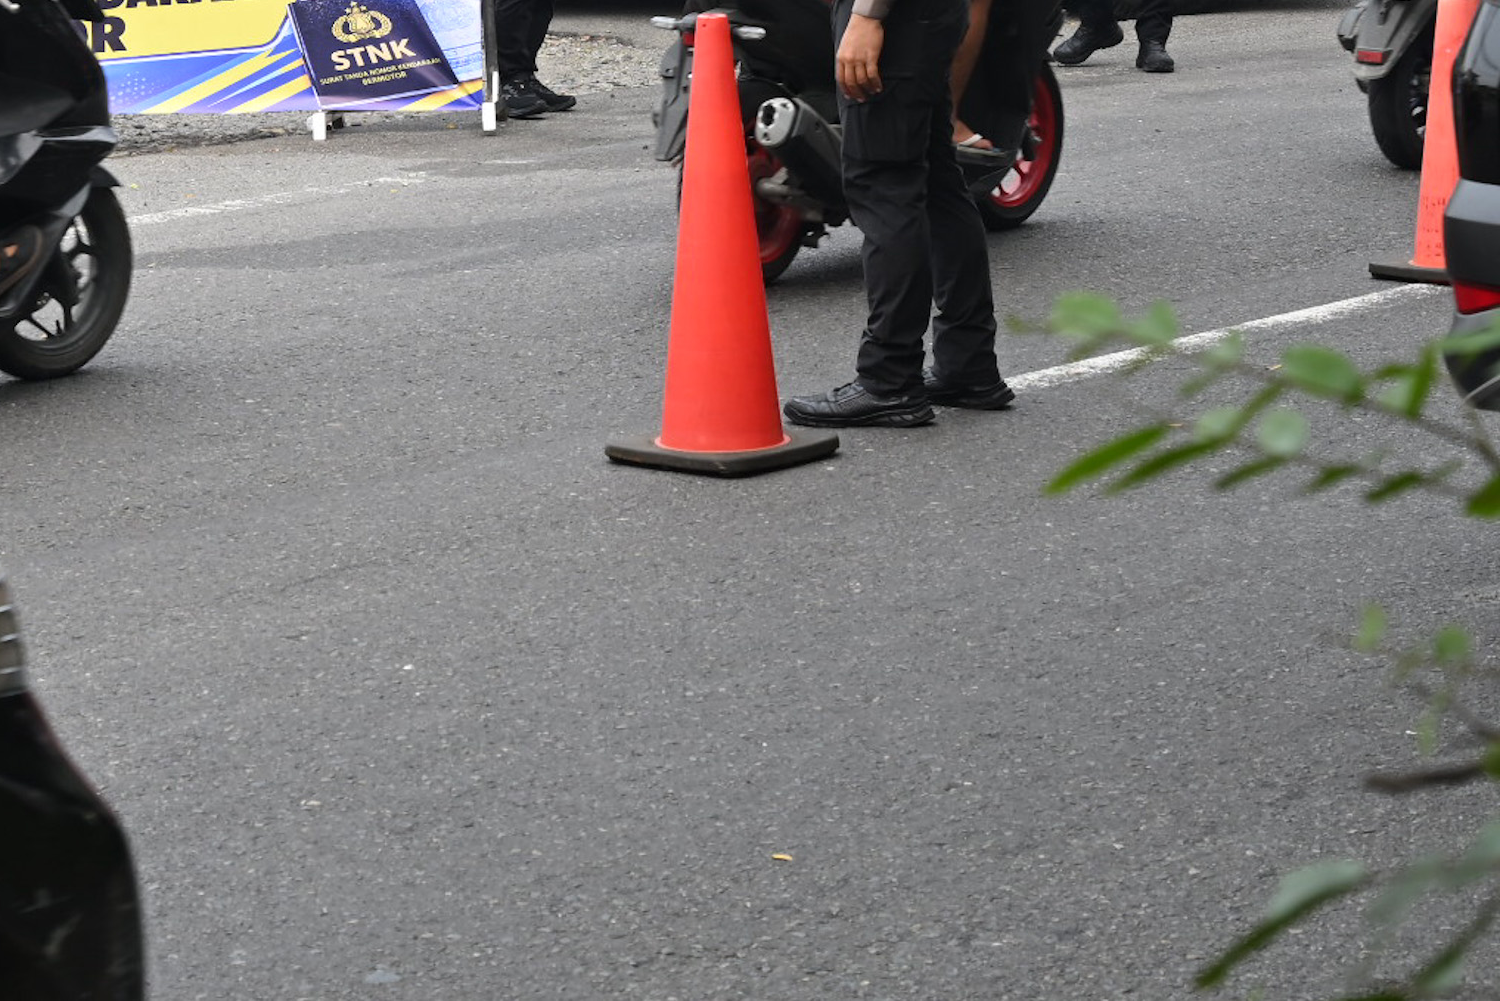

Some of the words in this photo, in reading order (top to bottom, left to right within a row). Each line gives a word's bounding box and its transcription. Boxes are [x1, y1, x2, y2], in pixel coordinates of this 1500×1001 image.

[331, 39, 416, 71] STNK
[319, 74, 344, 86] SURAT
[345, 70, 368, 81] TANDA
[369, 65, 397, 78] NOMOR
[398, 57, 441, 72] KENDARAAN
[362, 71, 407, 86] BERMOTOR
